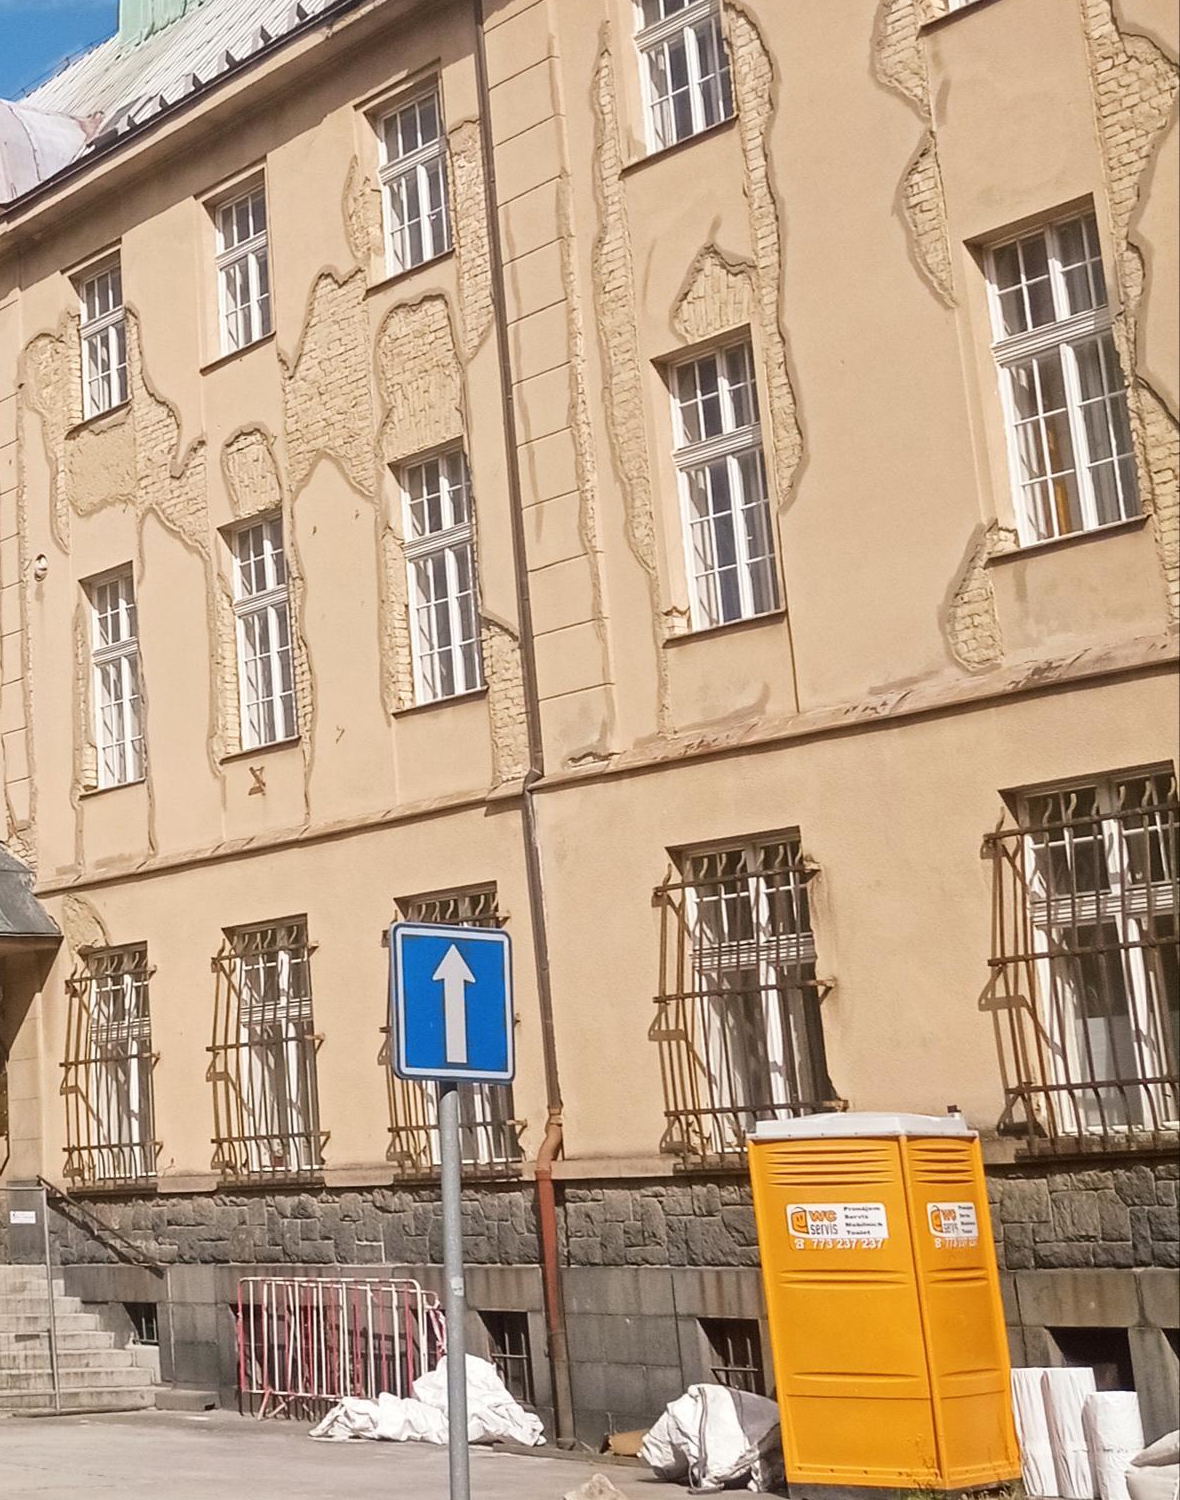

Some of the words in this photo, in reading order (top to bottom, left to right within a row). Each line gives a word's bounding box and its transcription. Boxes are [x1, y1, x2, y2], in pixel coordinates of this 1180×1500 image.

[808, 1210, 837, 1222] WC
[810, 1223, 838, 1235] servis
[811, 1238, 833, 1250] 773
[836, 1238, 859, 1250] 237
[861, 1238, 885, 1249] 237
